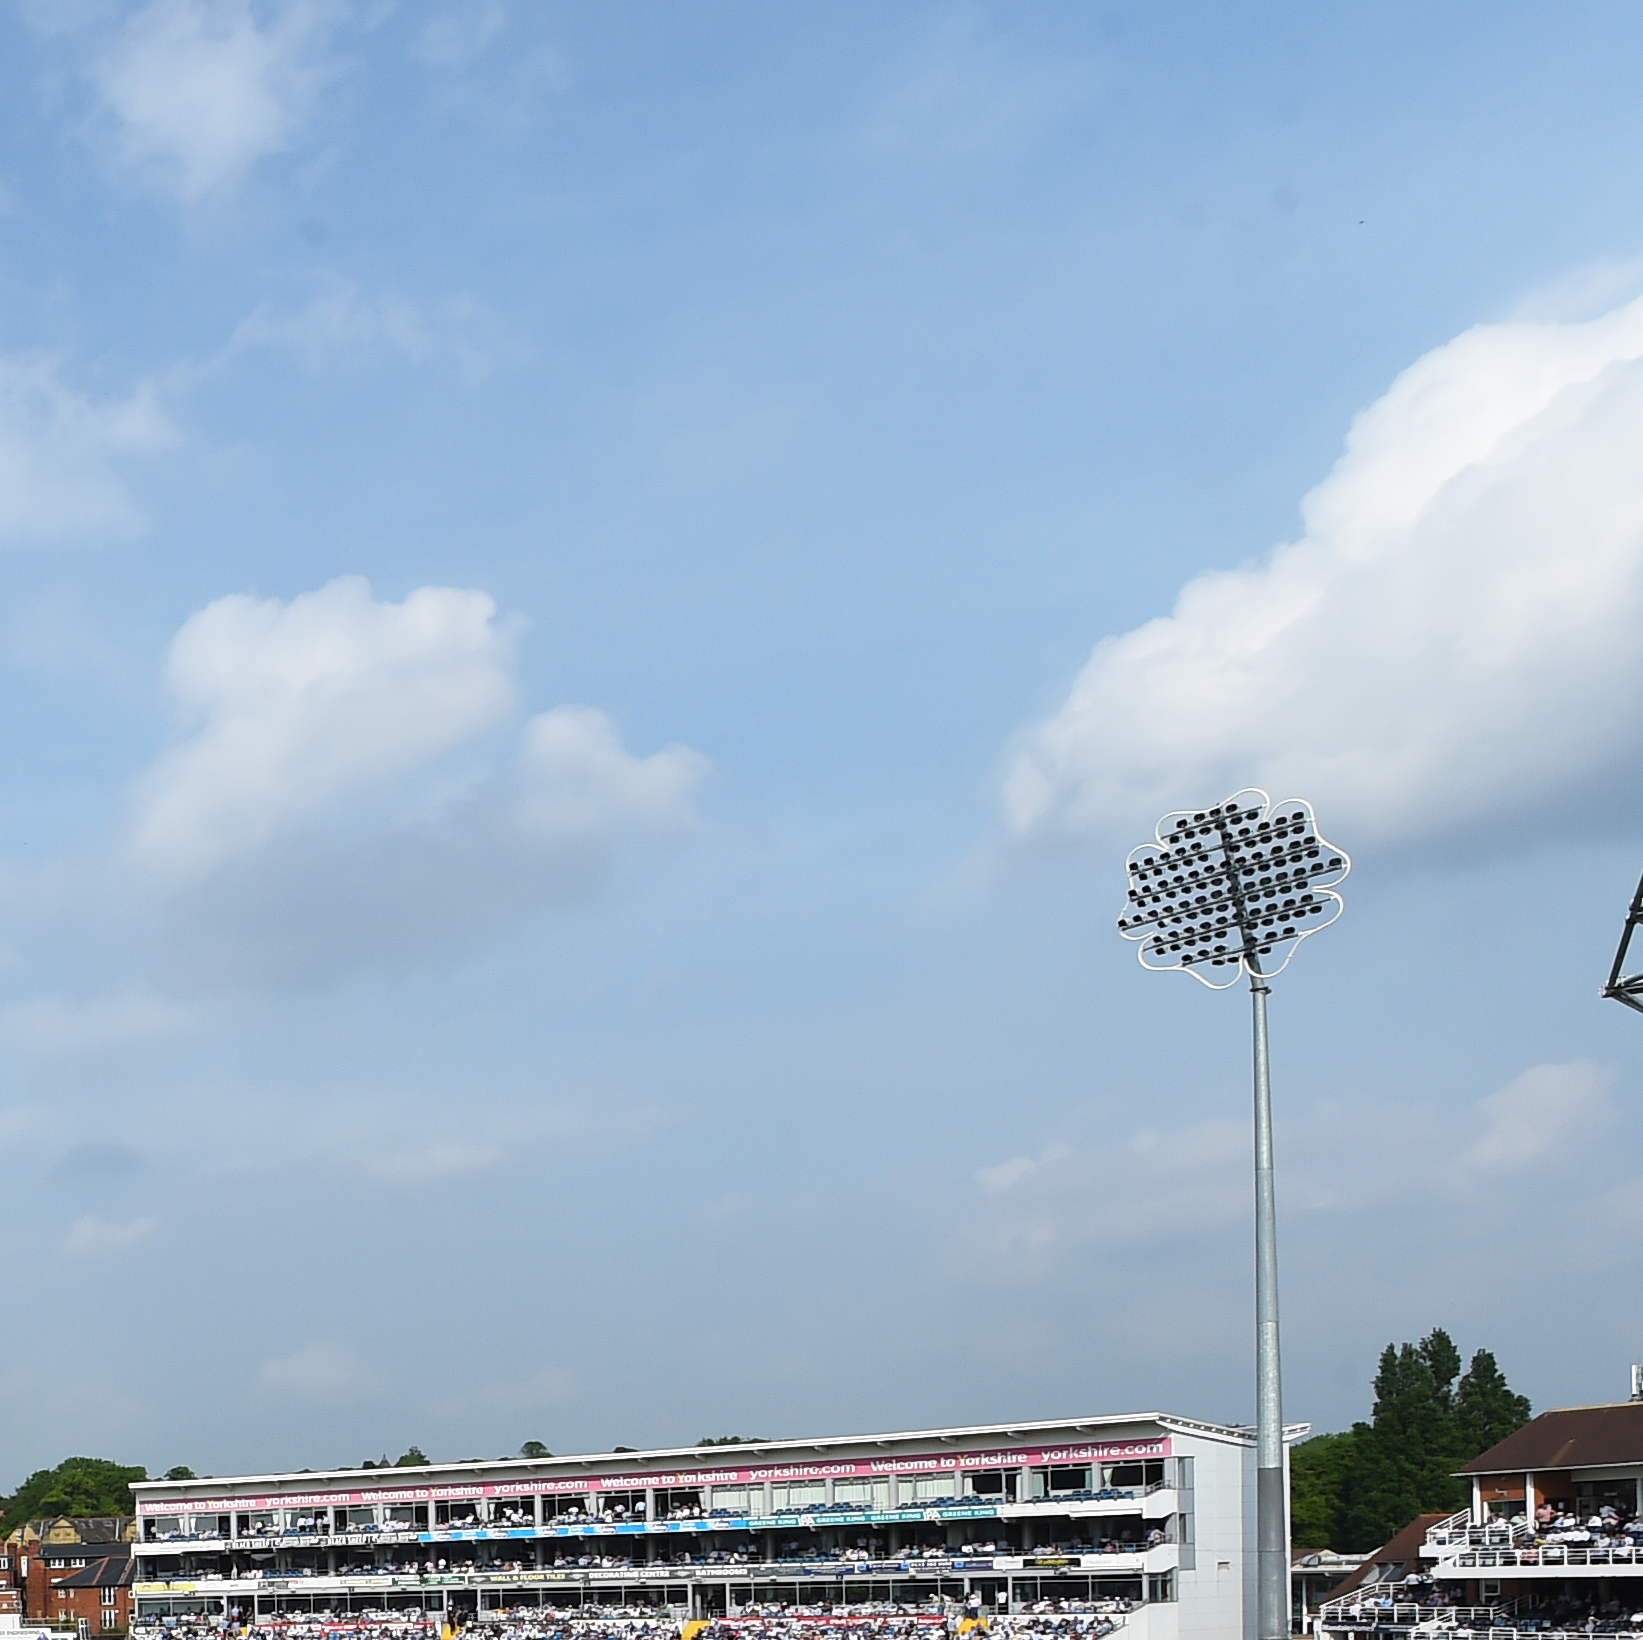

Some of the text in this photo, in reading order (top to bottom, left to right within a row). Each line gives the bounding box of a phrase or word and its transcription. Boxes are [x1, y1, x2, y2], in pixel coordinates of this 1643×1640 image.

[1041, 1443, 1164, 1462] yorkshire.com
[870, 1452, 1028, 1472] Welcome to Yorkshire
[749, 1464, 856, 1480] yorkshire.com
[494, 1480, 588, 1494] yorkshire.com
[600, 1472, 738, 1488] Welcome to Yorkshire
[265, 1494, 350, 1507] yorkshire.com
[361, 1486, 484, 1500] Welcome to Yorkshire
[144, 1498, 256, 1512] Welcome to Yorkshire
